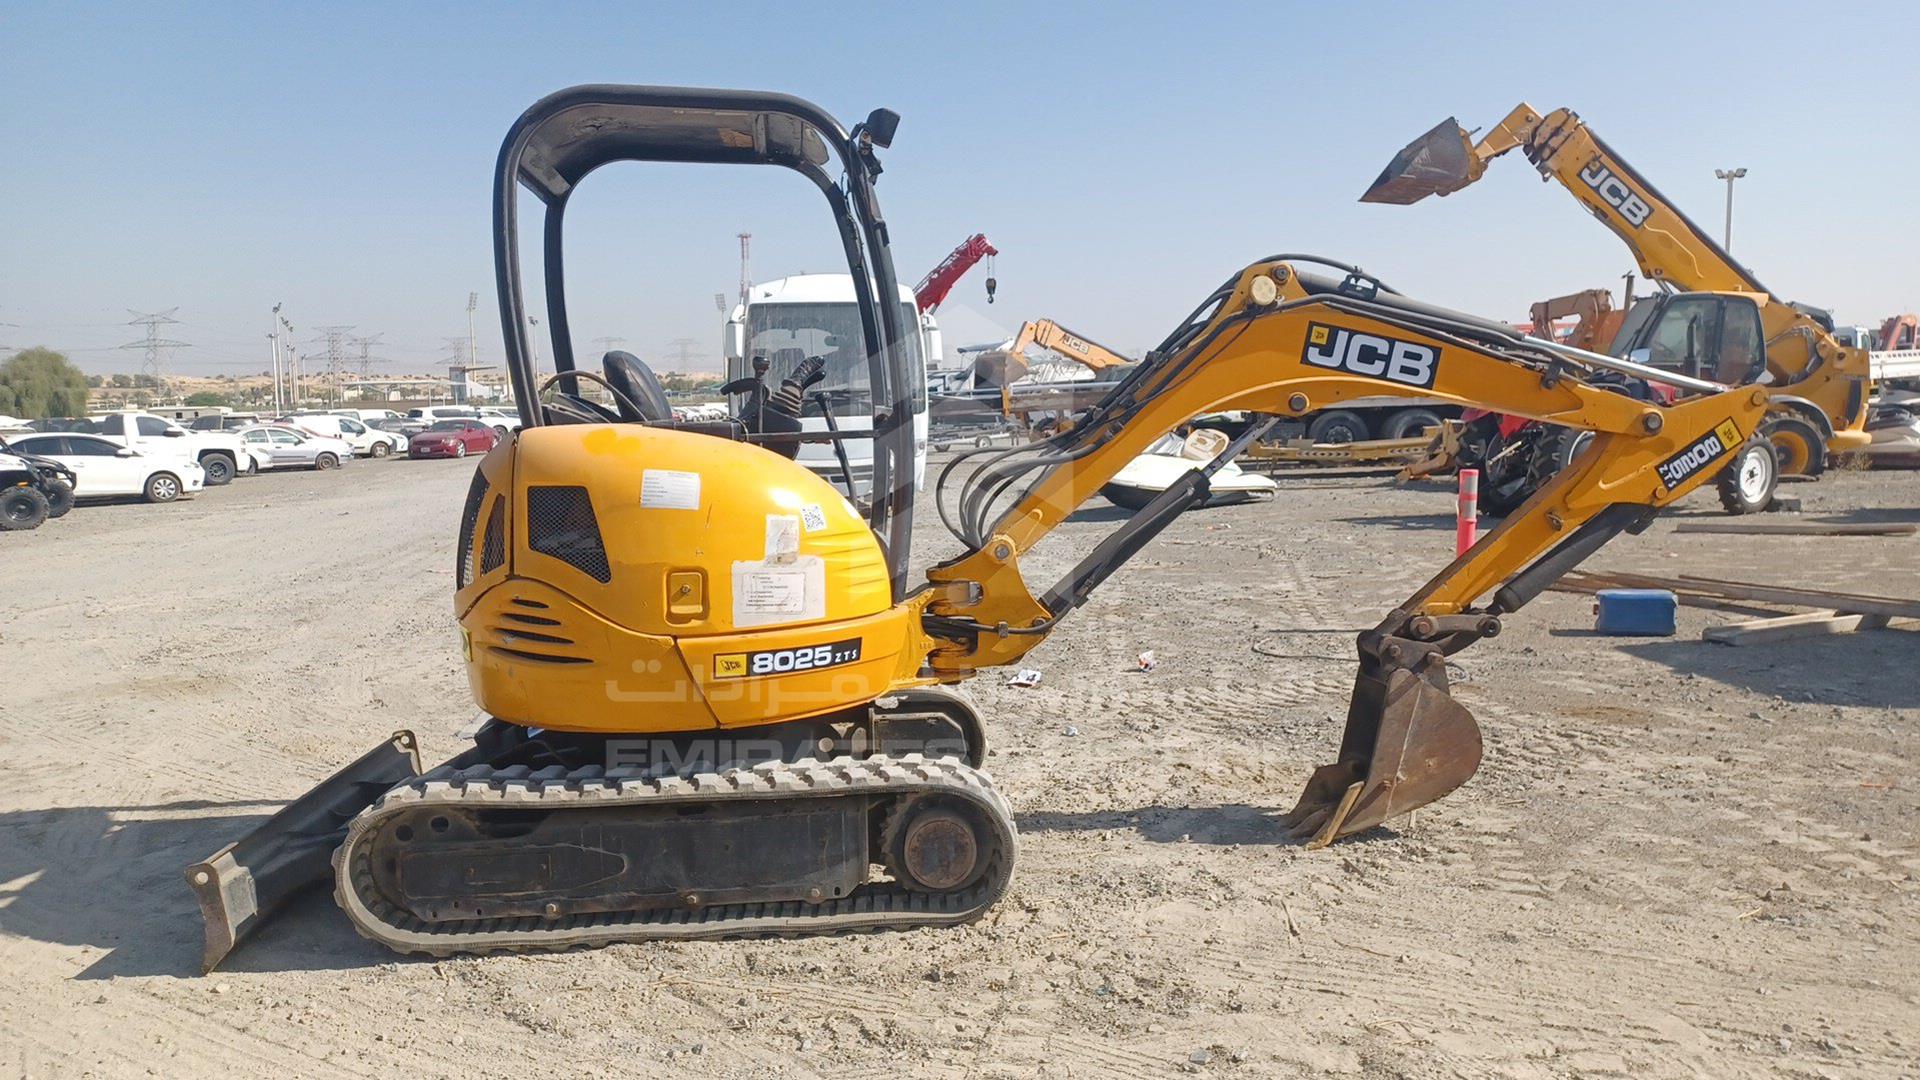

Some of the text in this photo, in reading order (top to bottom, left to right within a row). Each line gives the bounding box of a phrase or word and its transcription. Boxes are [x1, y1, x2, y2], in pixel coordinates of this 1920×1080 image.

[1581, 167, 1649, 225] JCB
[1063, 336, 1089, 353] JCB
[1307, 330, 1434, 385] JCB
[1669, 436, 1721, 479] 8025
[752, 646, 858, 674] 8025 ZTS
